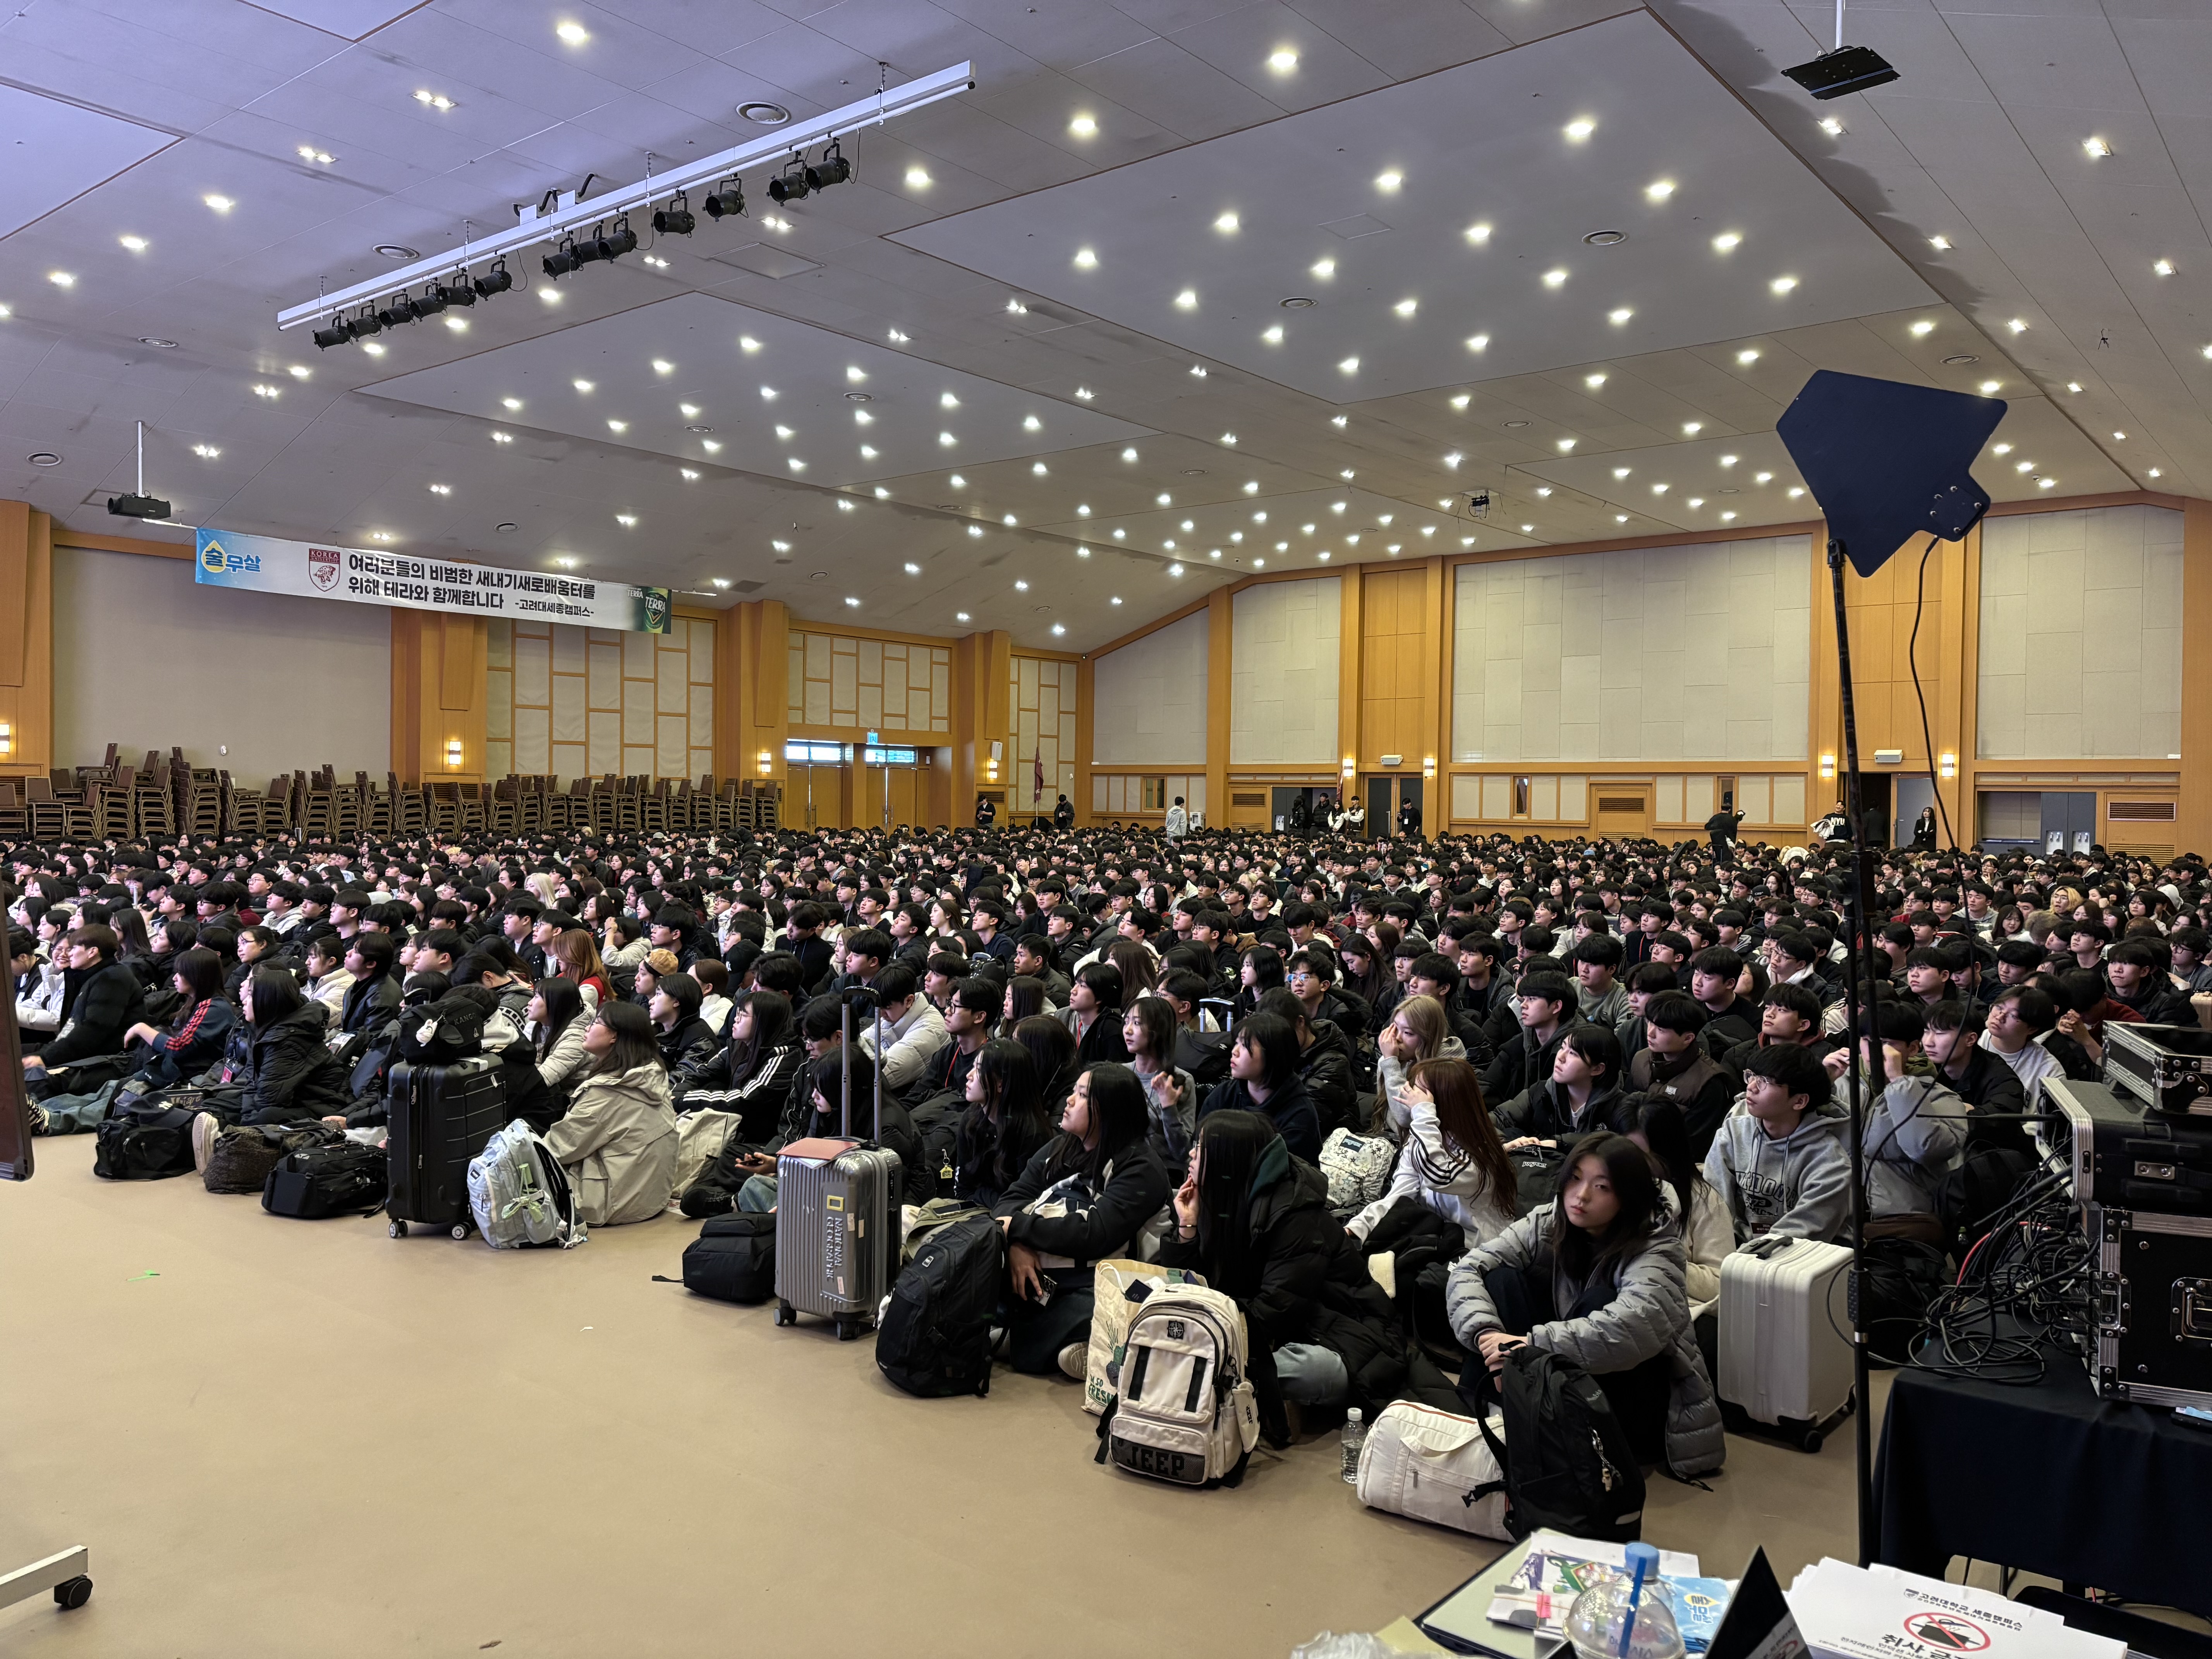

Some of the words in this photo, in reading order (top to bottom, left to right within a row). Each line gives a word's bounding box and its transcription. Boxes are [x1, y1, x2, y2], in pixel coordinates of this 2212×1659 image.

[205, 548, 261, 572] 술무살
[311, 550, 338, 558] KOREA
[349, 554, 424, 580] 여러분들의
[429, 565, 473, 585] 비범한
[476, 570, 595, 599] 새내기새로배움터를
[349, 576, 379, 596] 위해
[384, 581, 429, 601] 테라와
[433, 586, 504, 609] 함께합니다
[627, 590, 643, 598] TERRA
[645, 596, 666, 613] TERRA
[1831, 817, 1845, 825] NYU
[835, 1218, 843, 1268] NATIONAL
[1095, 1377, 1104, 1387] SO
[1127, 1446, 1184, 1477] JEEP
[1919, 1593, 1968, 1611] 고려대학교
[1881, 1634, 1925, 1653] 취사
